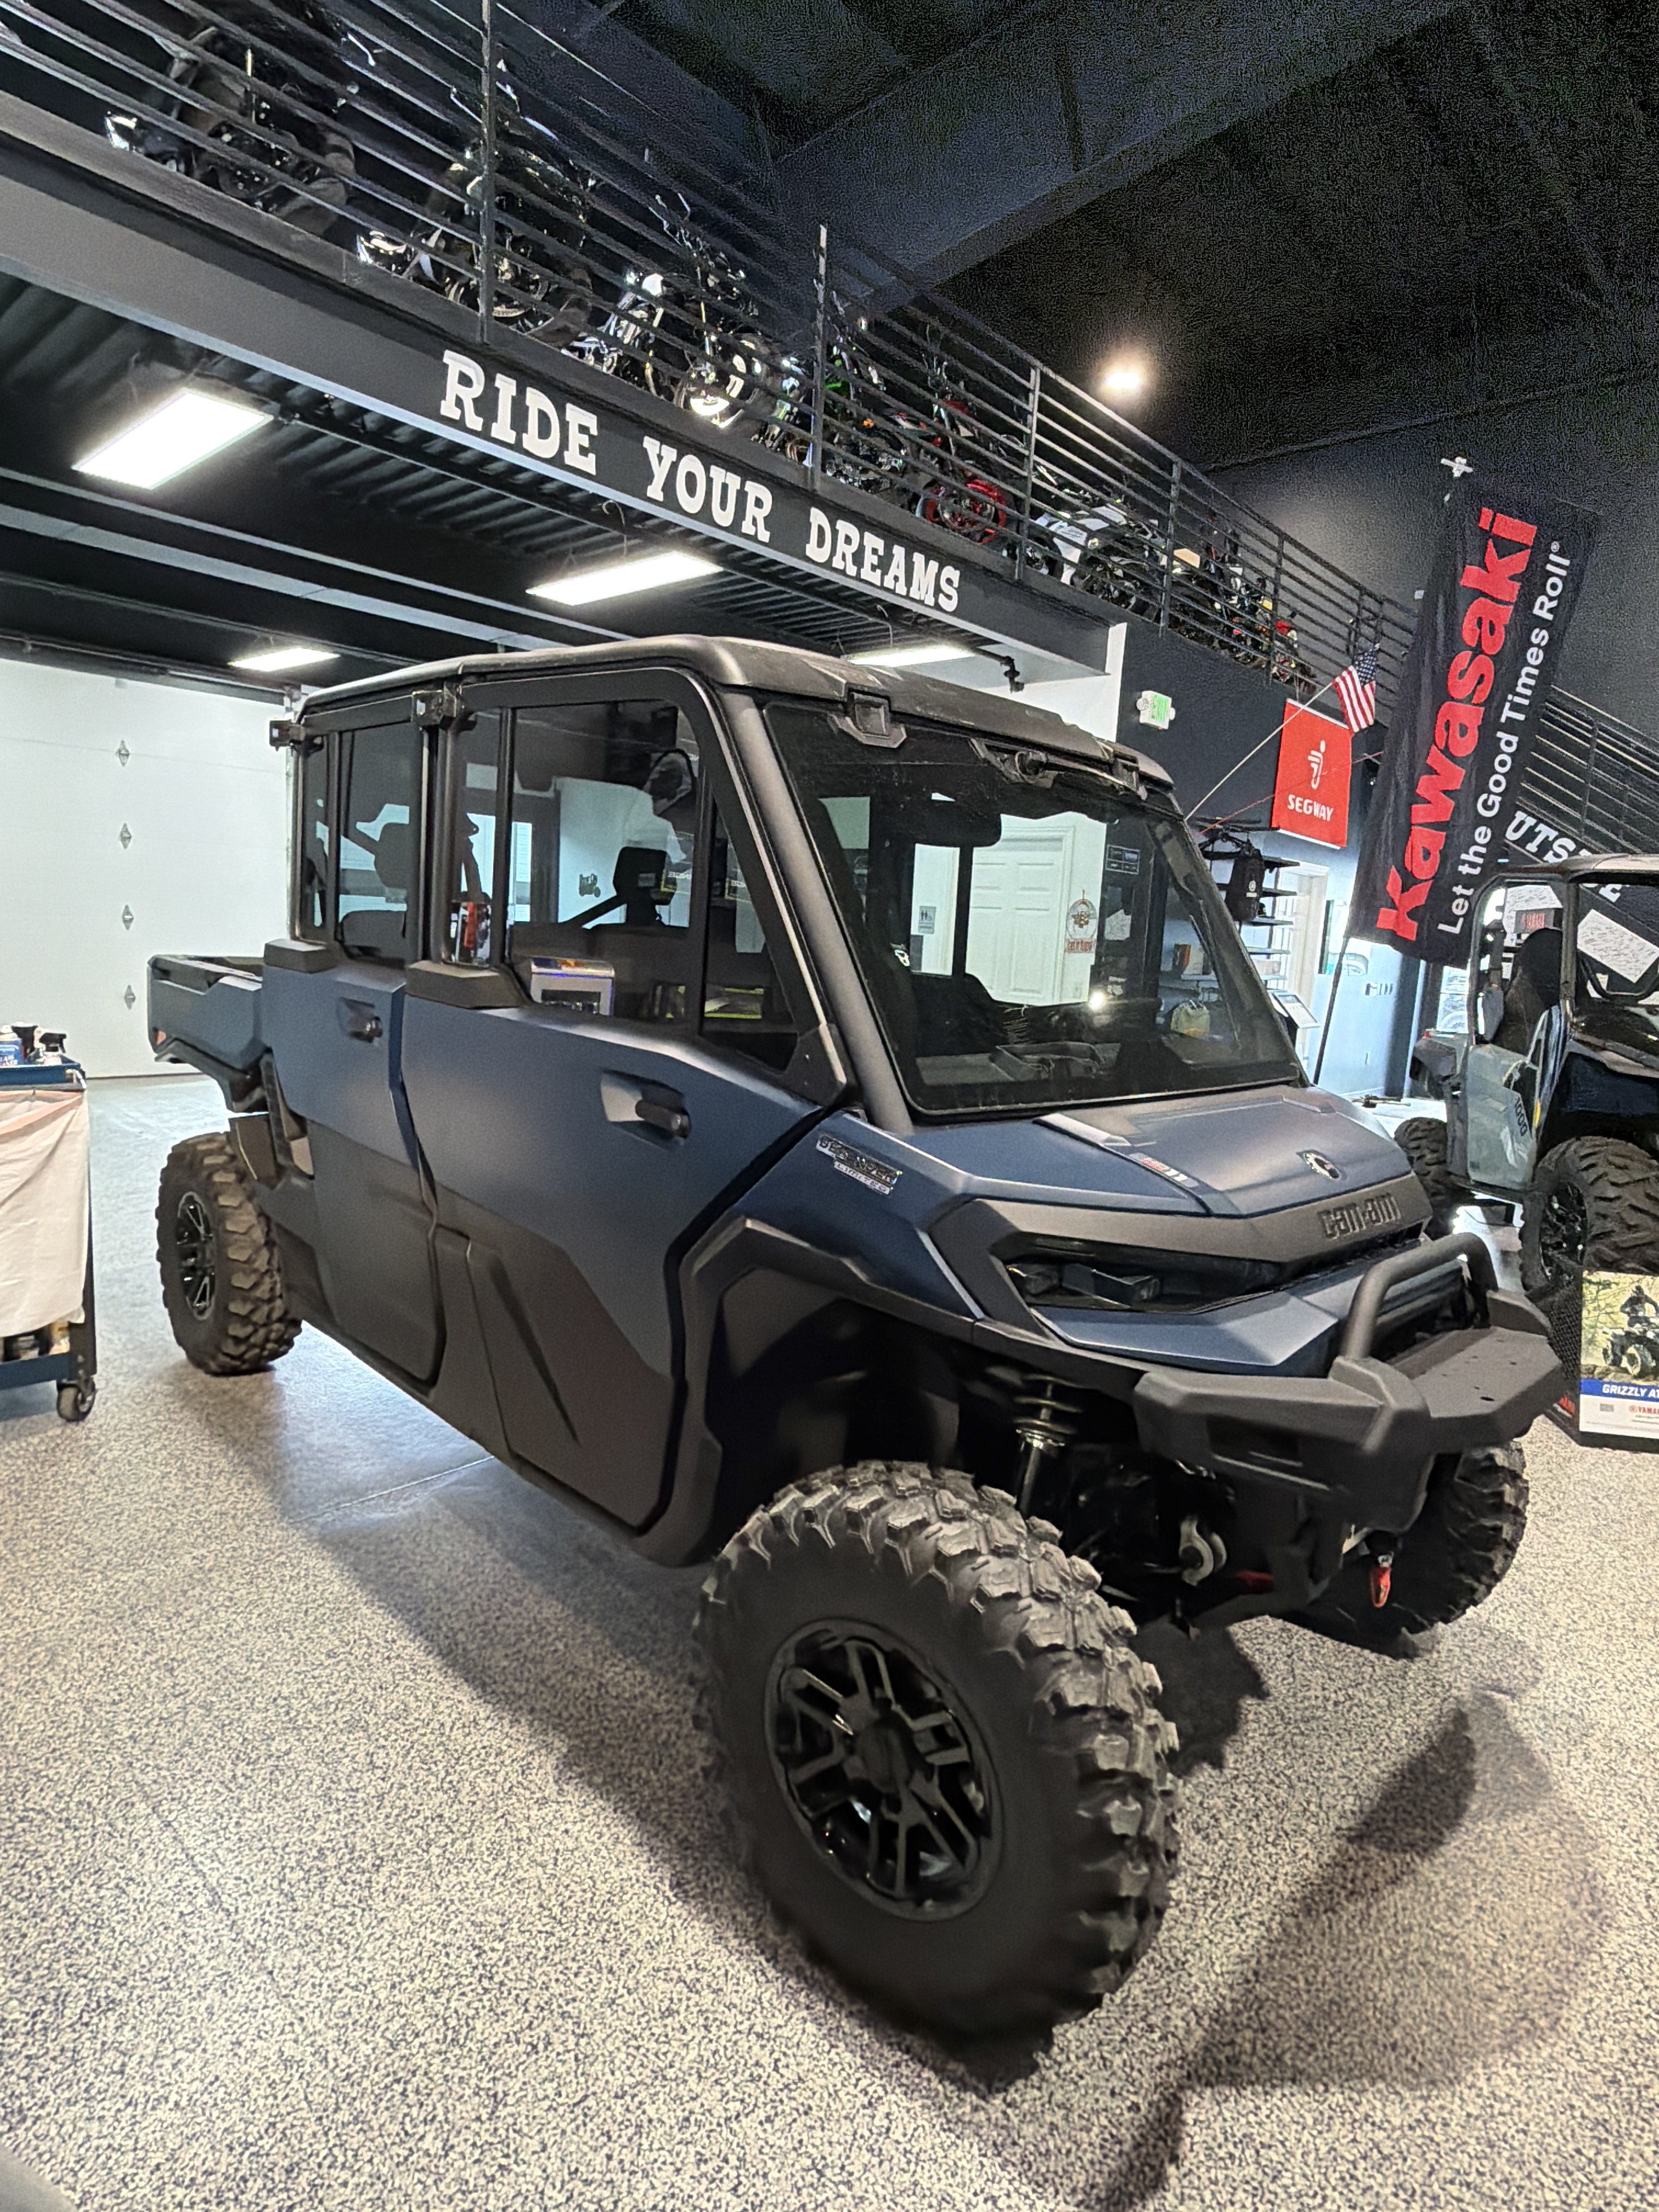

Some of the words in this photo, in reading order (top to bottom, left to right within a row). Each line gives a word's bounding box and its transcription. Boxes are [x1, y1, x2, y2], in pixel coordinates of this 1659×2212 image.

[441, 349, 598, 476] RIDE
[643, 436, 772, 543] YOUR
[805, 506, 961, 612] DREAMS
[1376, 507, 1537, 941] Kawasaki
[1437, 884, 1475, 935] Let
[1458, 825, 1492, 875] the
[1477, 731, 1519, 817] Good
[1500, 628, 1550, 723] Times
[1287, 793, 1334, 822] SEGWAY
[1514, 1097, 1528, 1137] 1000
[819, 1135, 901, 1185] DENDER
[1602, 1384, 1647, 1397] GRIZZLY
